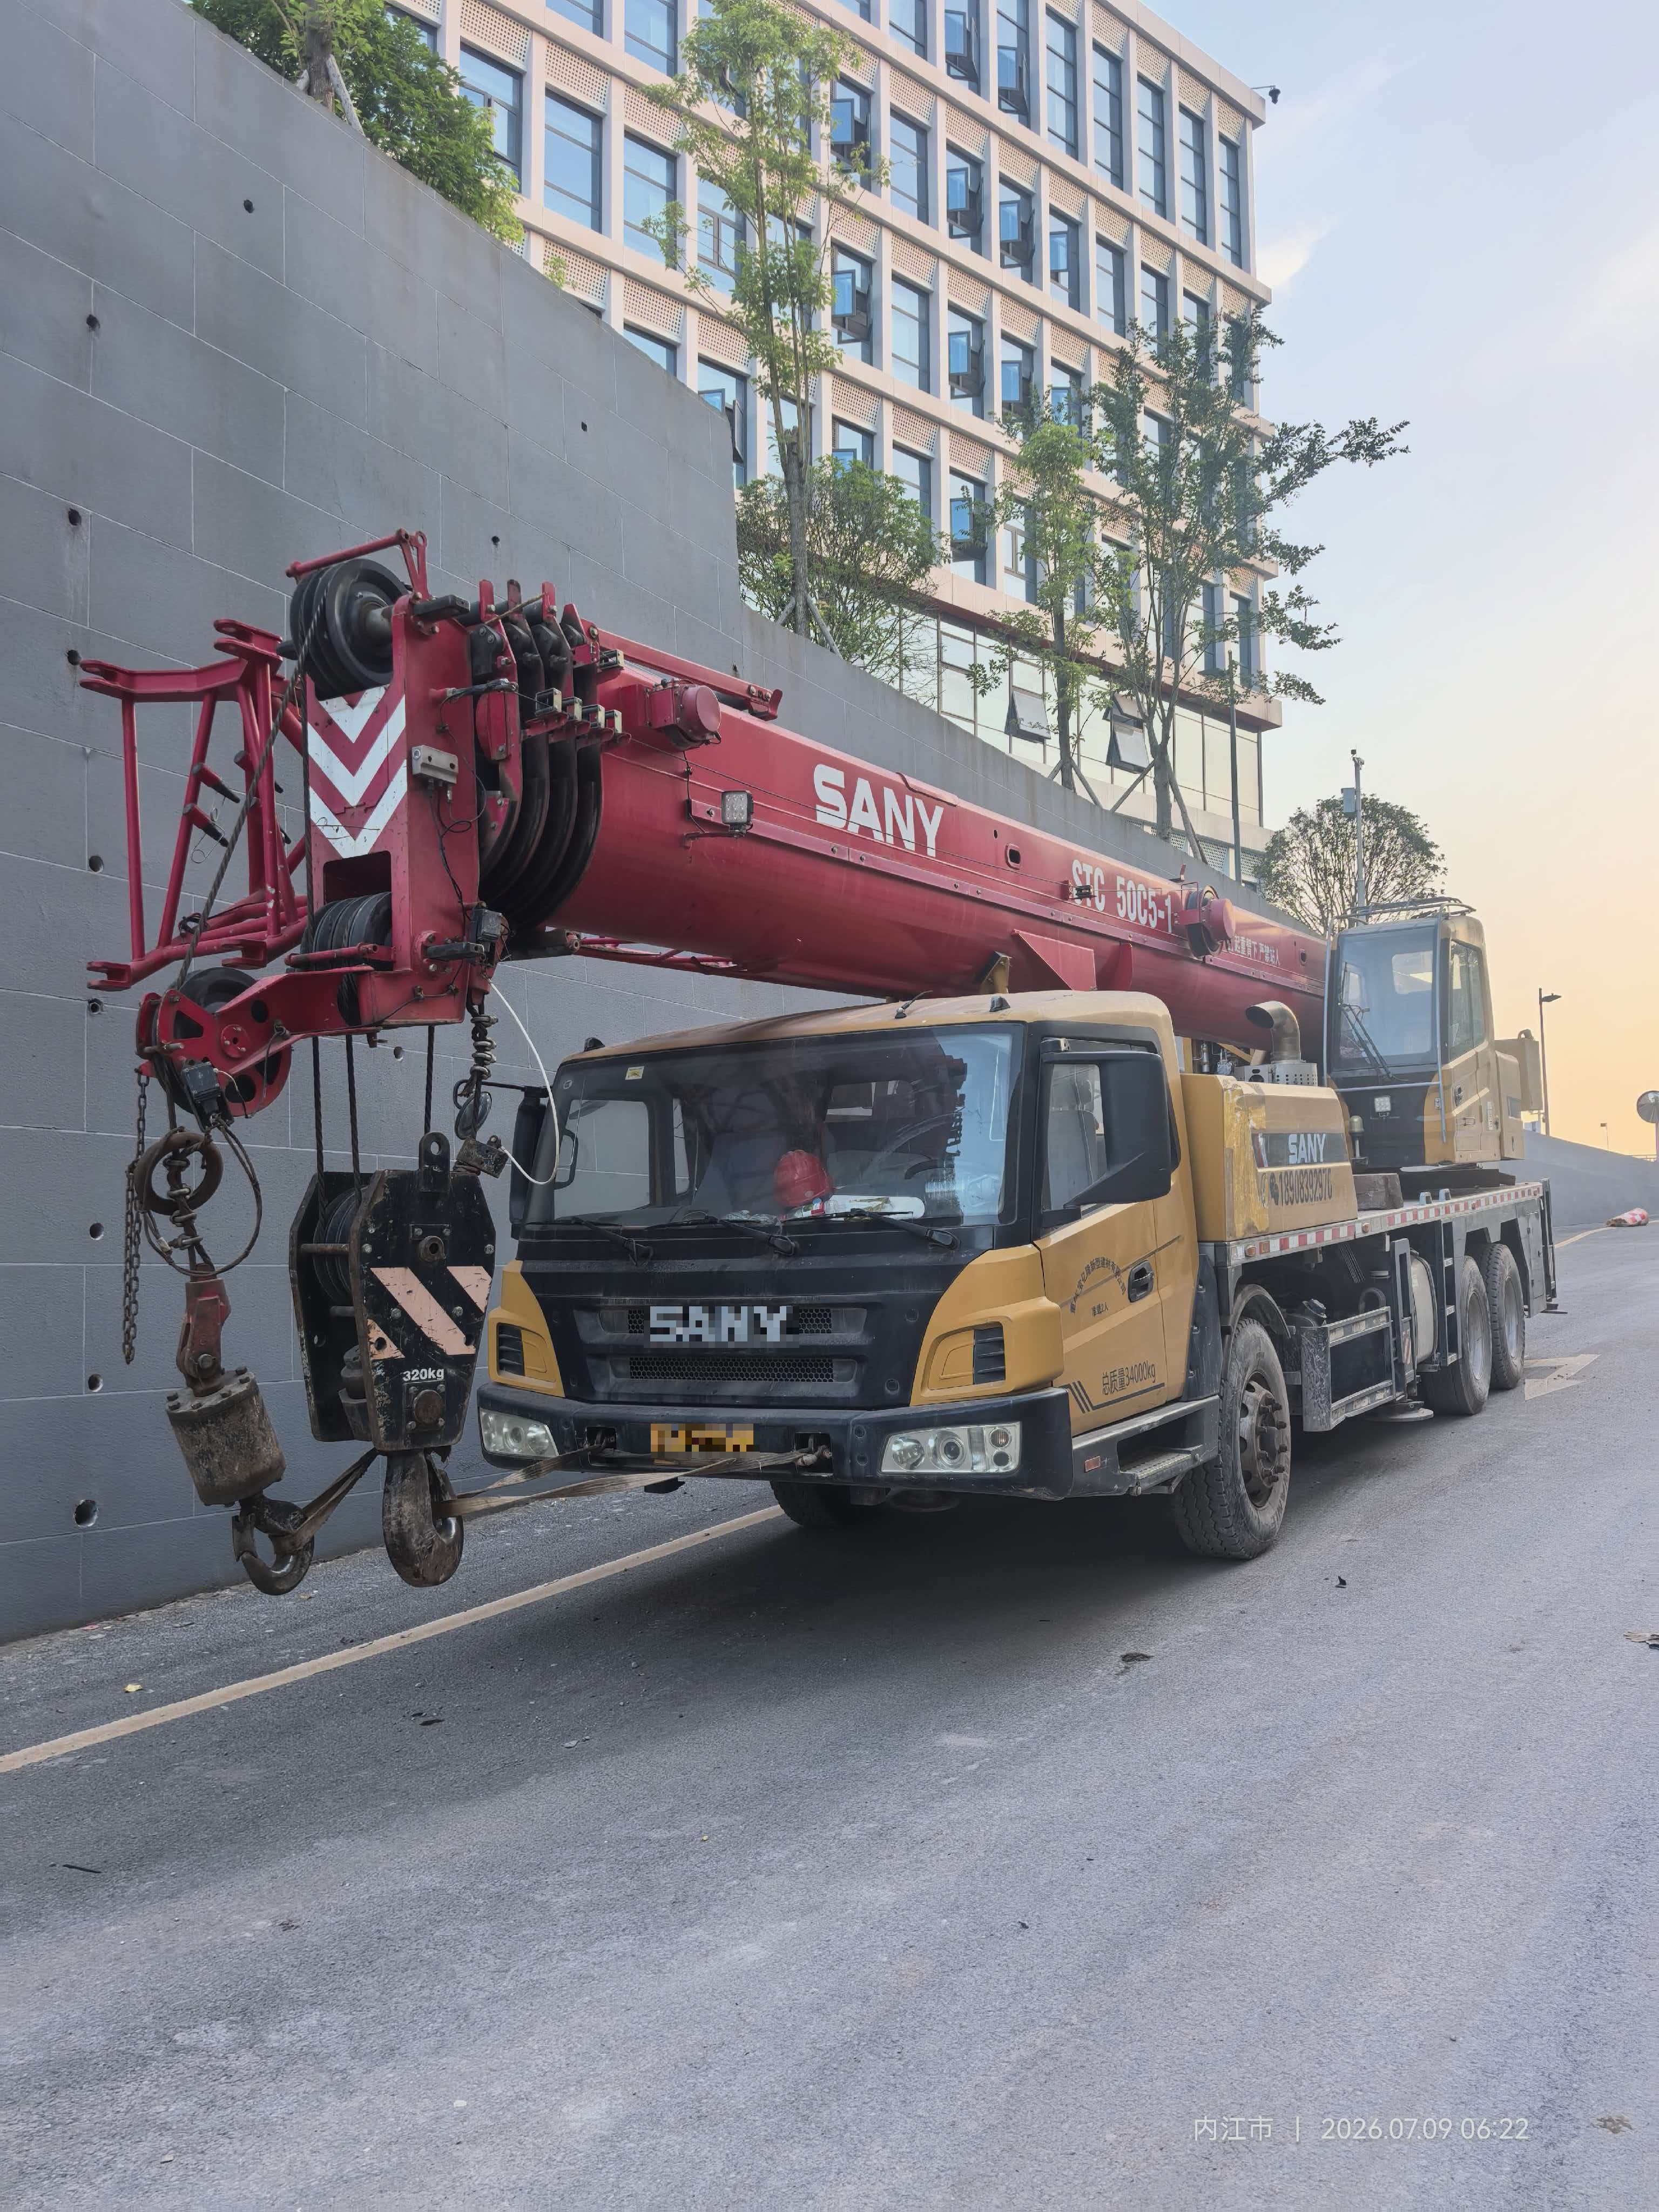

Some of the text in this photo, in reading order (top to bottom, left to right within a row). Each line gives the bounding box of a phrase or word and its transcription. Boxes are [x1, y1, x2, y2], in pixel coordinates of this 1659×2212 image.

[813, 764, 944, 858] SANY
[1072, 859, 1172, 934] STC 50C5-1
[1288, 1134, 1326, 1164] SANY
[402, 1368, 444, 1382] 320kg
[1102, 1359, 1156, 1395] 总质量34000kg
